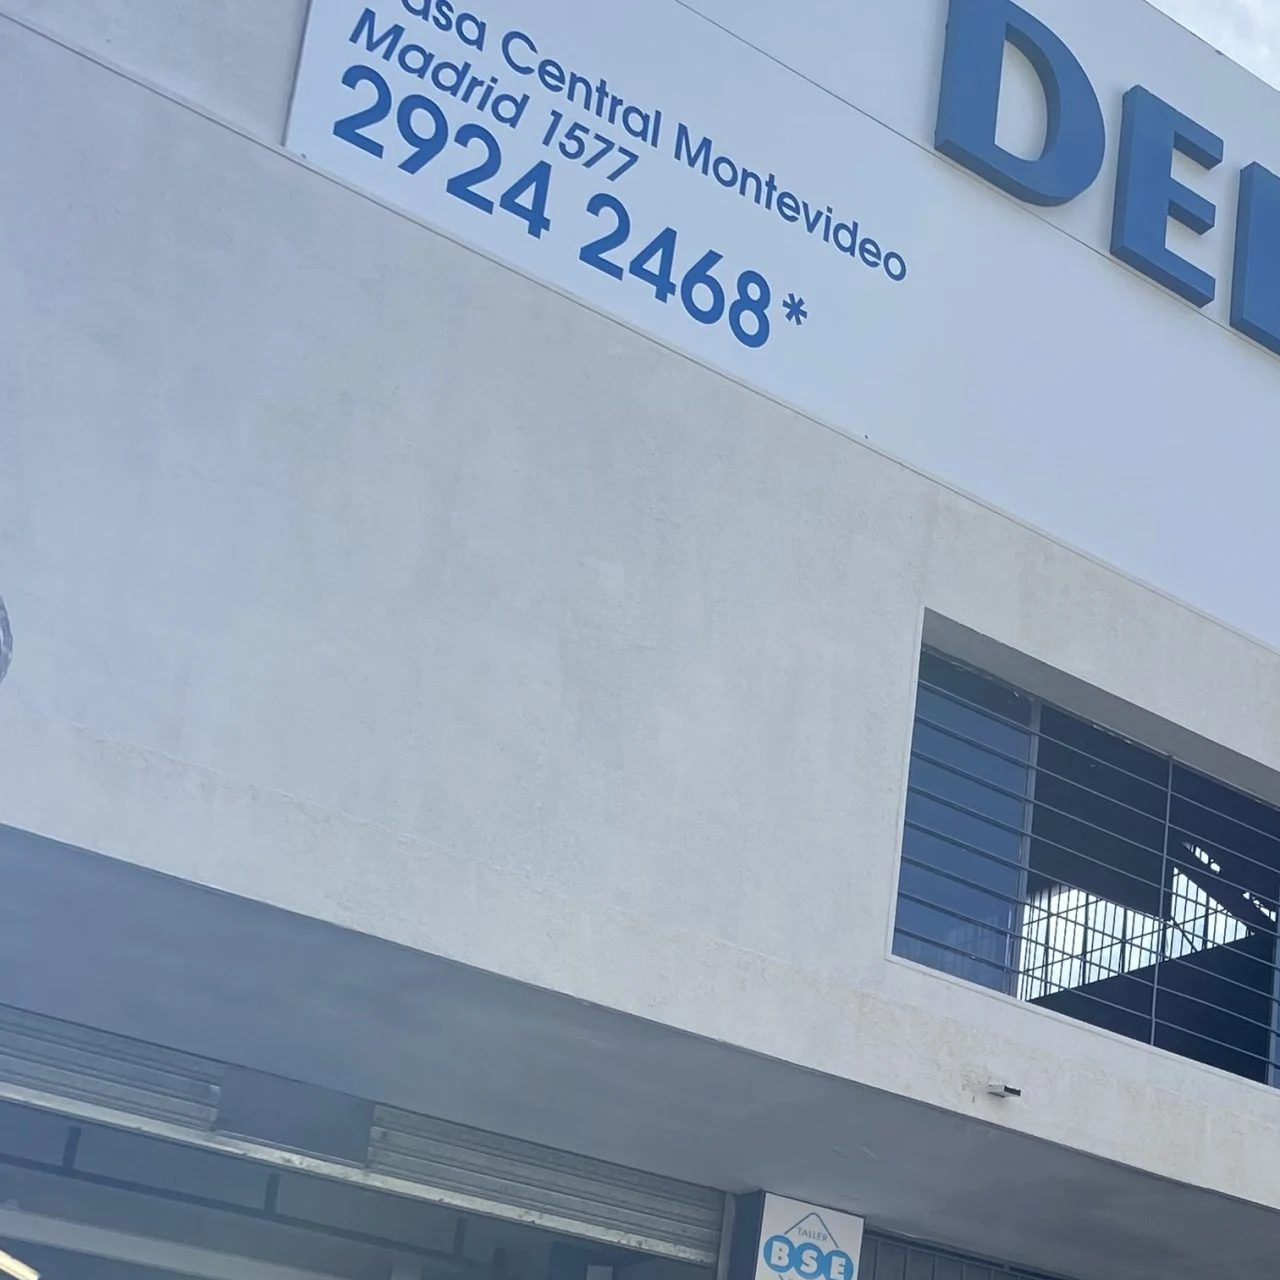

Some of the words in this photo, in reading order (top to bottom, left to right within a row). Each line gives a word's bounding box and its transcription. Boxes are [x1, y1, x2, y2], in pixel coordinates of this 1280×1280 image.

[333, 65, 552, 239] 2924
[349, 8, 530, 129] Madrid
[541, 109, 639, 183] 1577
[402, 0, 487, 51] asa
[501, 30, 661, 147] Central
[675, 123, 907, 281] Montevideo
[797, 1227, 828, 1242] TALLER
